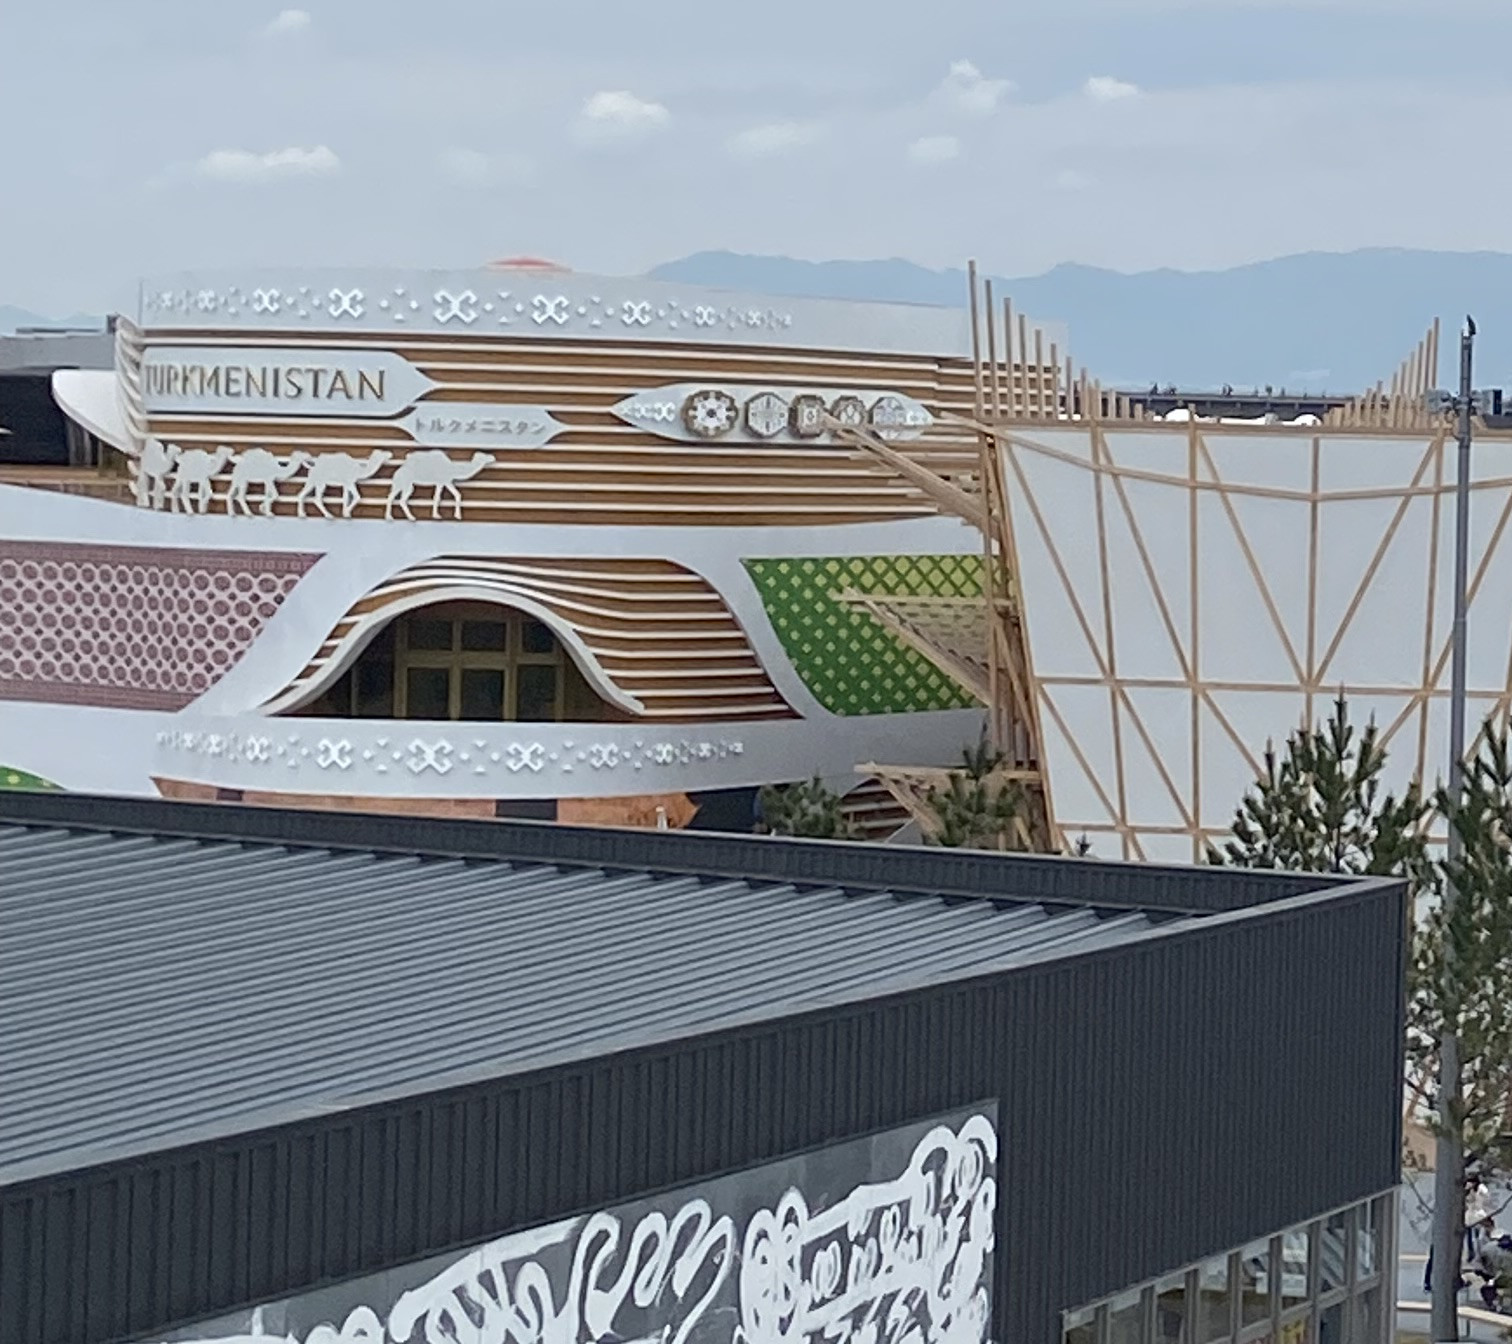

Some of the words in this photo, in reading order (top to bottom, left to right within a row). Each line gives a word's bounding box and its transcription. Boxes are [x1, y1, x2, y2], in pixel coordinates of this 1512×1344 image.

[144, 364, 386, 402] TURKMENISTAN
[415, 417, 546, 435] トルクメニスタン
